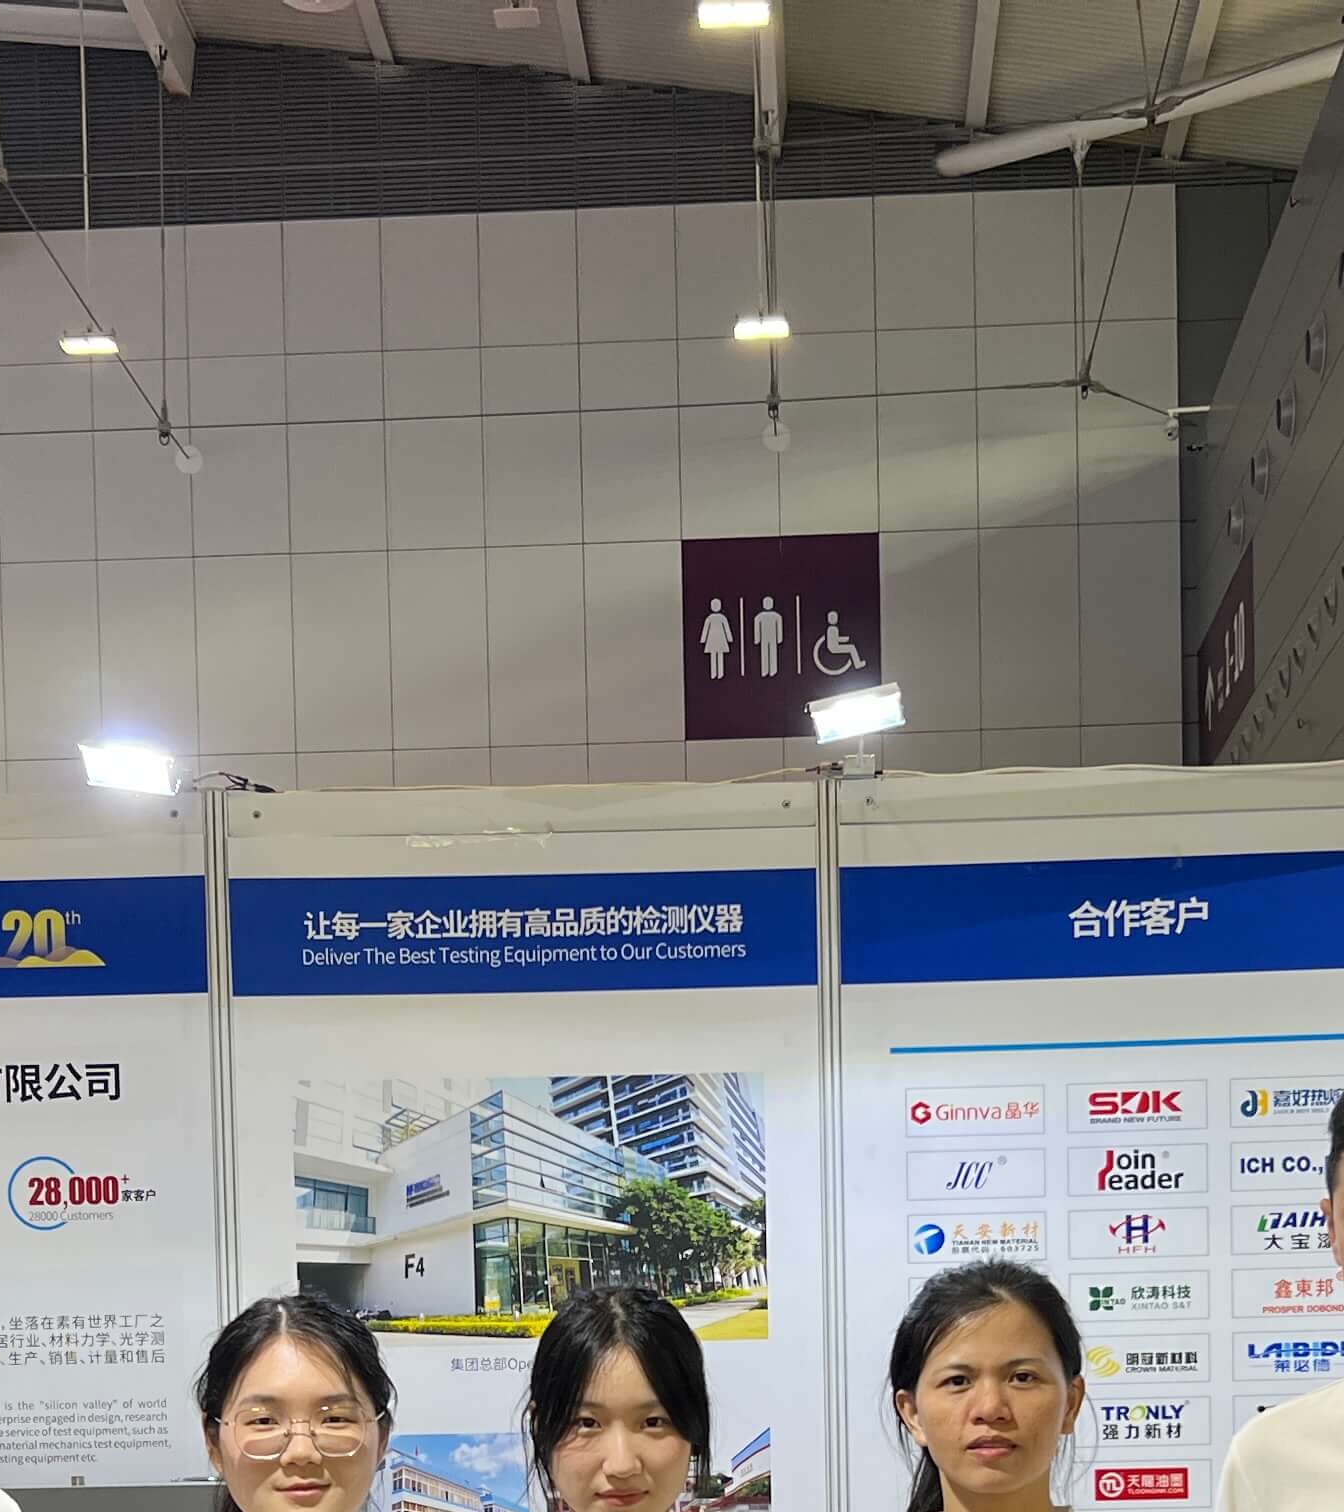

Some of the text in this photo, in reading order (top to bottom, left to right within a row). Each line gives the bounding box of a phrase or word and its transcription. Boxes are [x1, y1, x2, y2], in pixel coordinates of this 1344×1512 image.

[303, 903, 744, 941] 让每一家企业拥有高品质的检测仪器
[1069, 896, 1210, 939] 合作客户
[302, 940, 747, 968] Deliver The Best Testing Equipment to Our Customers
[935, 1103, 1001, 1121] Ginnva
[121, 1188, 157, 1203] 家客户
[61, 1210, 114, 1222] Customers
[404, 1254, 425, 1279] F4
[4, 1402, 13, 1411] is
[17, 1401, 35, 1411] the
[122, 1399, 134, 1409] of
[138, 1398, 167, 1409] world
[32, 1413, 76, 1426] engaged
[77, 1413, 87, 1422] in
[87, 1412, 124, 1425] design,
[124, 1412, 168, 1423] research
[5, 1428, 40, 1438] service
[41, 1427, 53, 1437] of
[53, 1428, 72, 1437] test
[72, 1427, 132, 1438] equipment,
[132, 1426, 155, 1436] such
[156, 1426, 169, 1436] as
[38, 1440, 92, 1450] mechanics
[93, 1440, 113, 1450] test
[113, 1439, 172, 1451] equipment,
[24, 1453, 80, 1465] equipment
